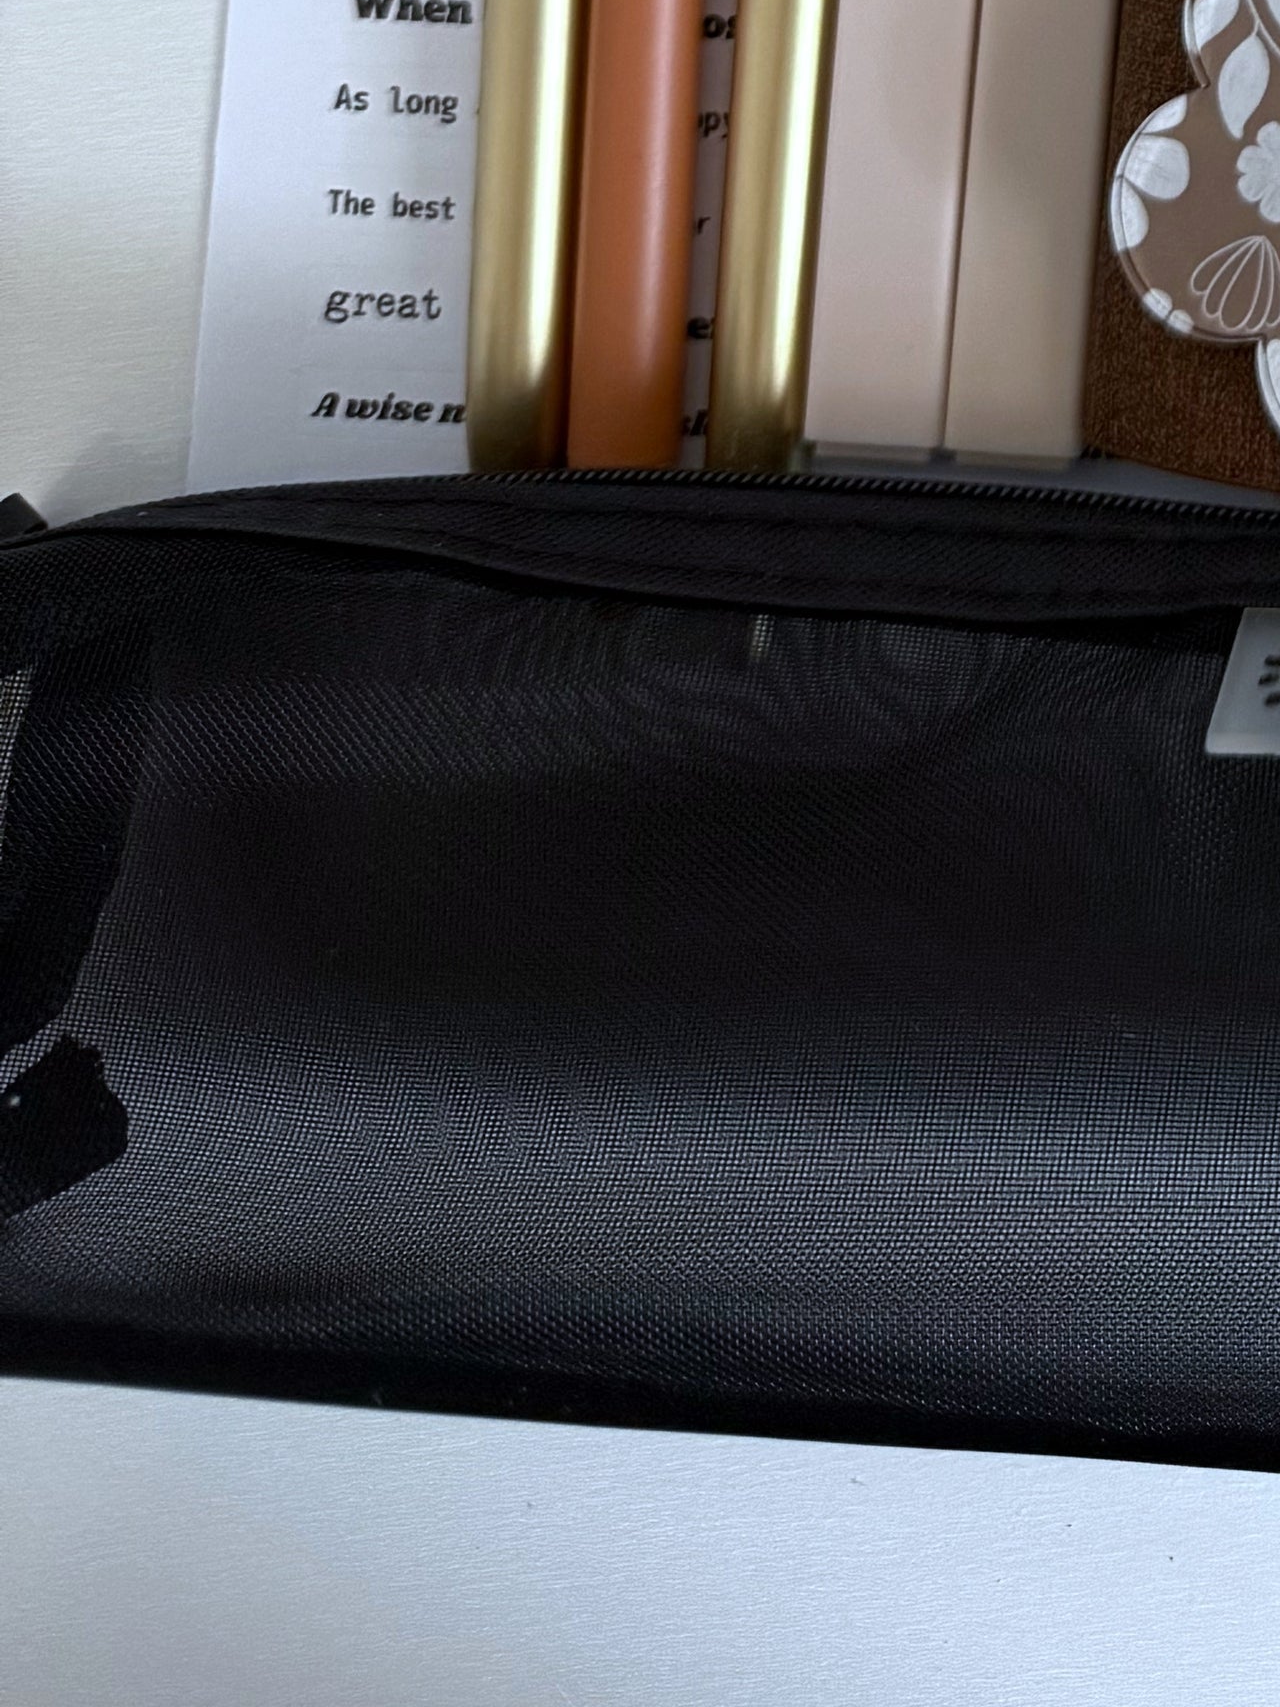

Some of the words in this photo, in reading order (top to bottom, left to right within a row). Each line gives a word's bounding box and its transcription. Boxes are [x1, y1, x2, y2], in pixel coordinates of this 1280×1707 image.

[334, 84, 369, 113] As
[389, 86, 459, 125] long
[327, 188, 375, 218] The
[391, 191, 457, 222] best
[323, 288, 442, 325] great
[310, 391, 341, 419] A
[345, 391, 435, 423] wise
